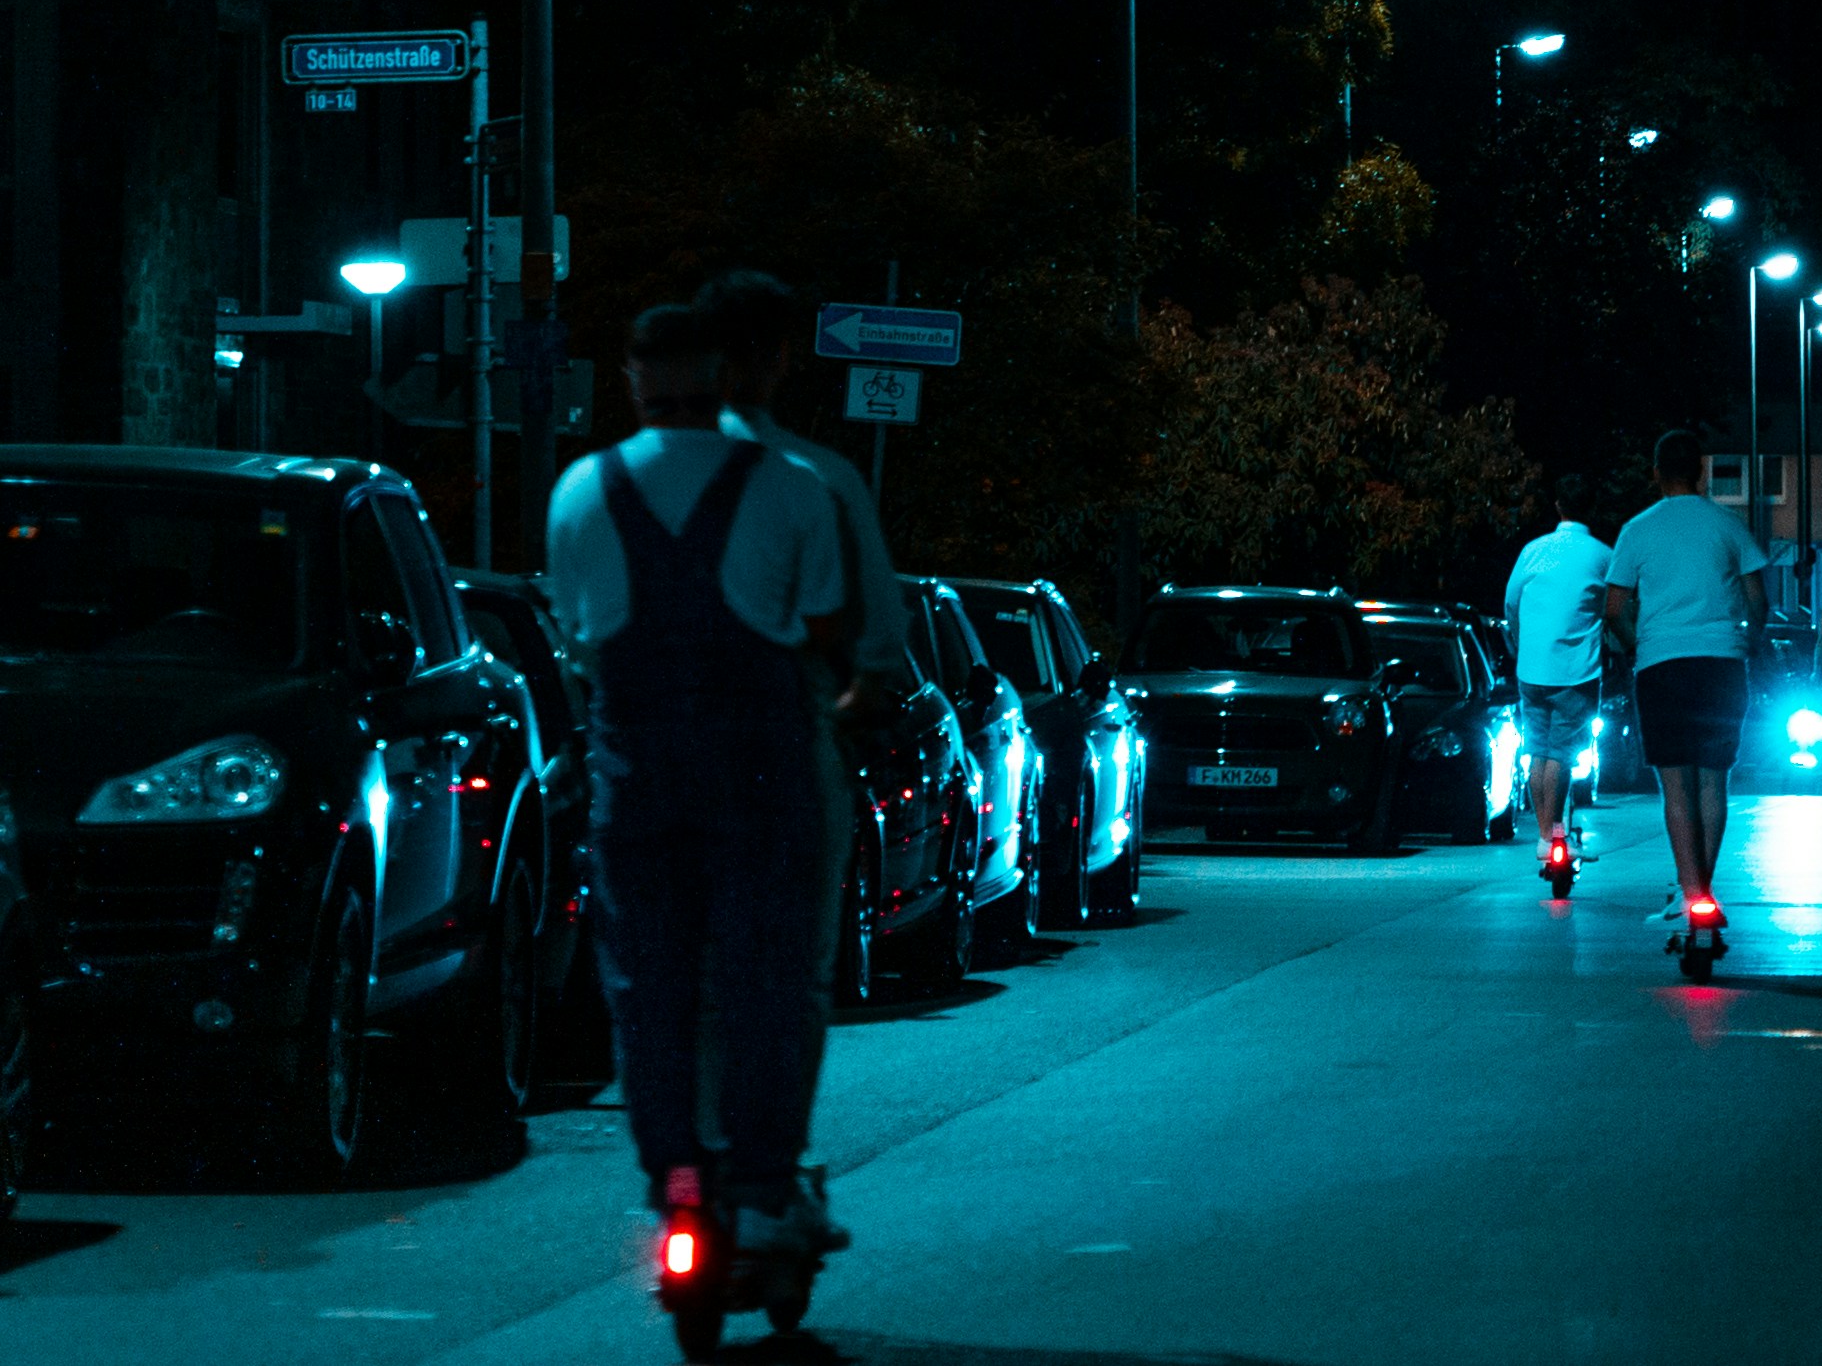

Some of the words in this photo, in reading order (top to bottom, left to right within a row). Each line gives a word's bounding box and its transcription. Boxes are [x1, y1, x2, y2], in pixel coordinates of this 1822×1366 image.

[306, 45, 441, 70] Schützenstraße
[309, 92, 354, 110] 10-14
[858, 326, 950, 344] Einbahnstraße
